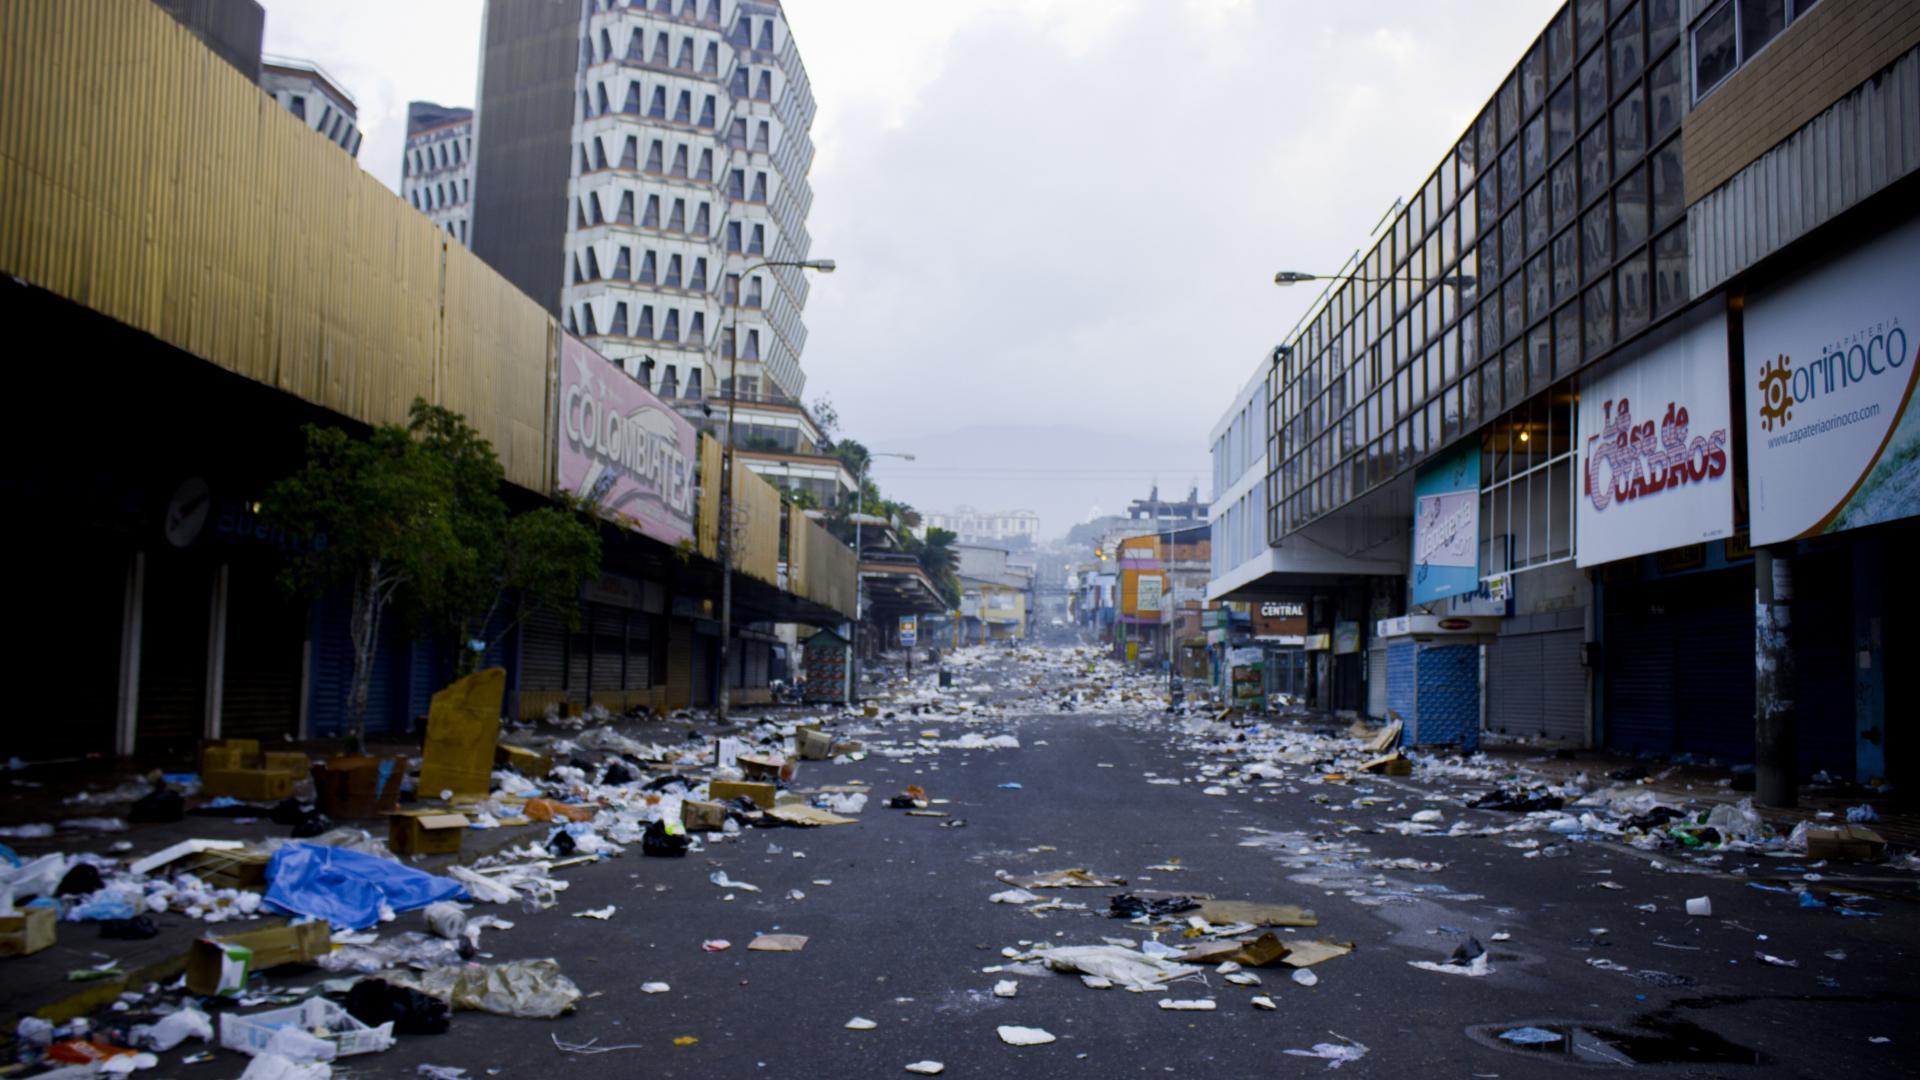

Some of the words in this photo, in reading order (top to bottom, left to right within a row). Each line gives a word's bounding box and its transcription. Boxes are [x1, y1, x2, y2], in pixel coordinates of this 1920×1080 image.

[1828, 316, 1899, 354] ZAPATERIA
[1793, 327, 1907, 403] orinoco
[1603, 398, 1631, 440] La
[1661, 401, 1689, 446] de
[1767, 402, 1880, 450] www.zapateriaorinoco.com
[565, 384, 697, 517] COLOMBIATEX
[1261, 605, 1303, 617] CENTRAL
